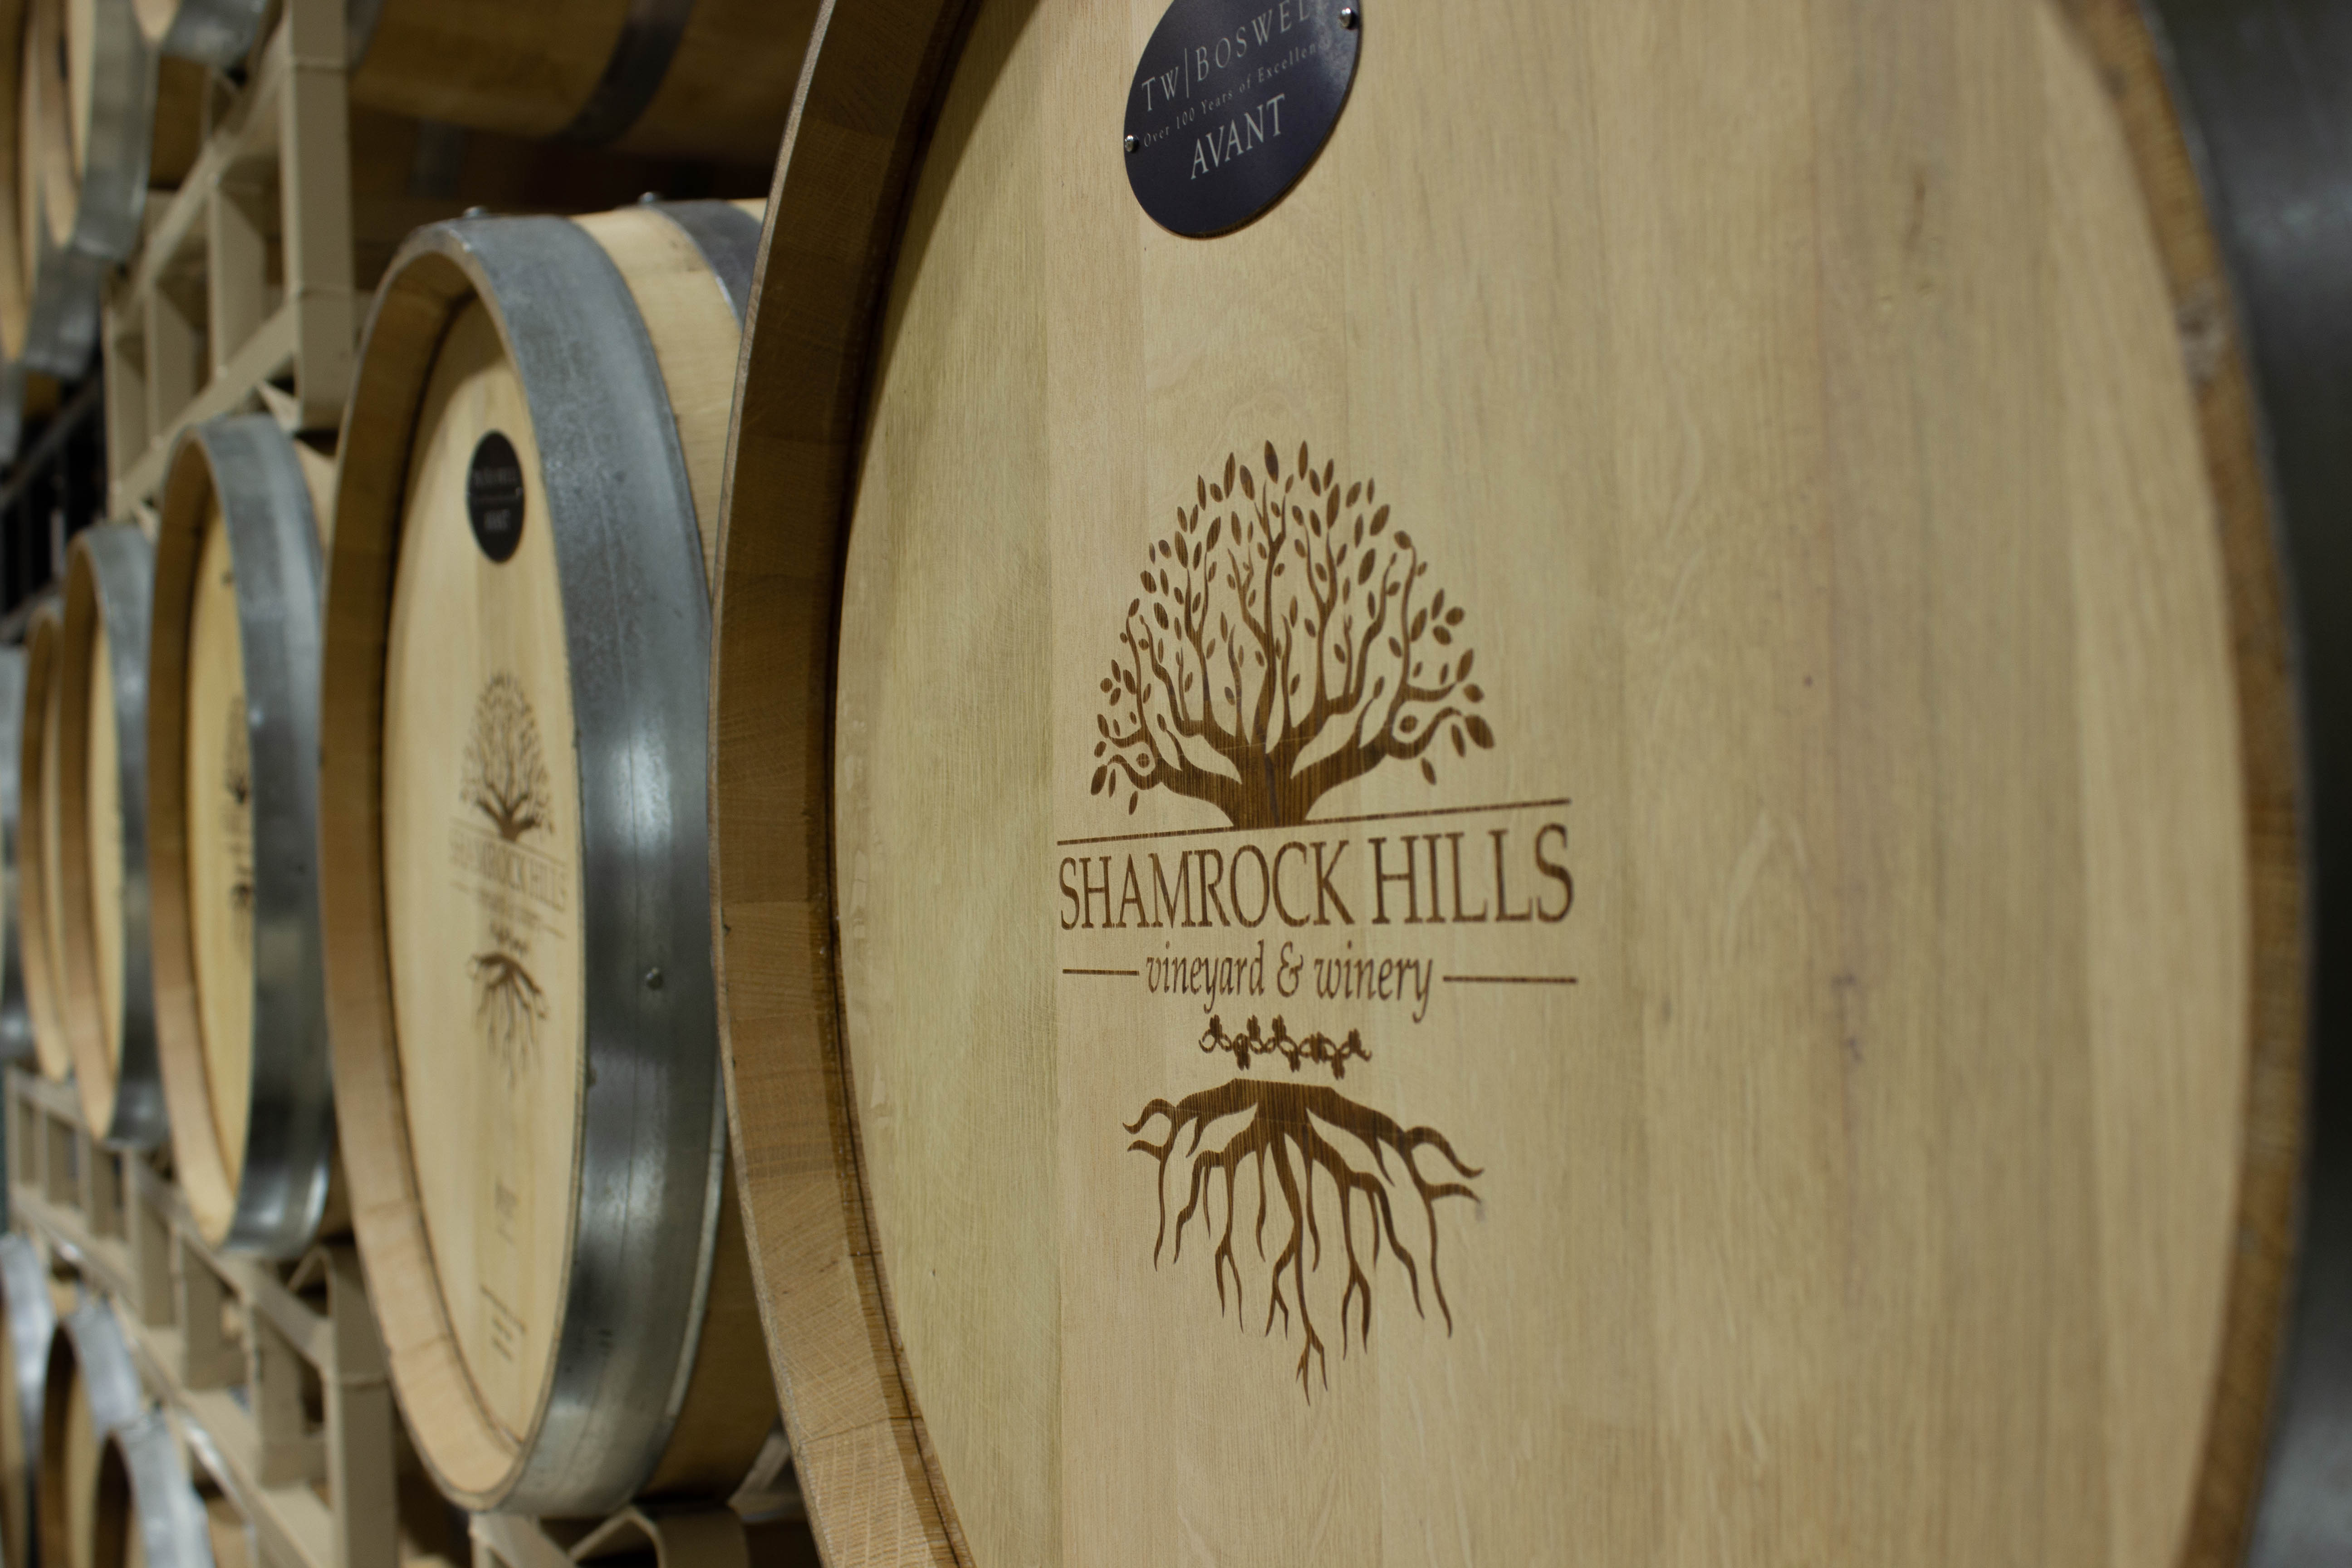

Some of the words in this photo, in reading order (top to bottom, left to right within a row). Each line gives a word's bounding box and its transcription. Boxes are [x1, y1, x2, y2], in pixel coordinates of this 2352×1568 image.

[1143, 126, 1170, 147] Over
[1176, 107, 1195, 130] 100
[1201, 90, 1233, 115] Years
[1239, 73, 1252, 93] of
[1258, 40, 1324, 83] Excellen
[1190, 93, 1285, 180] AVANT
[1058, 839, 1355, 931] SHAMROCK
[1368, 823, 1575, 926] HILLS
[1145, 939, 1266, 1014] vineyard
[1277, 941, 1303, 998] &
[1314, 940, 1434, 1024] winery
